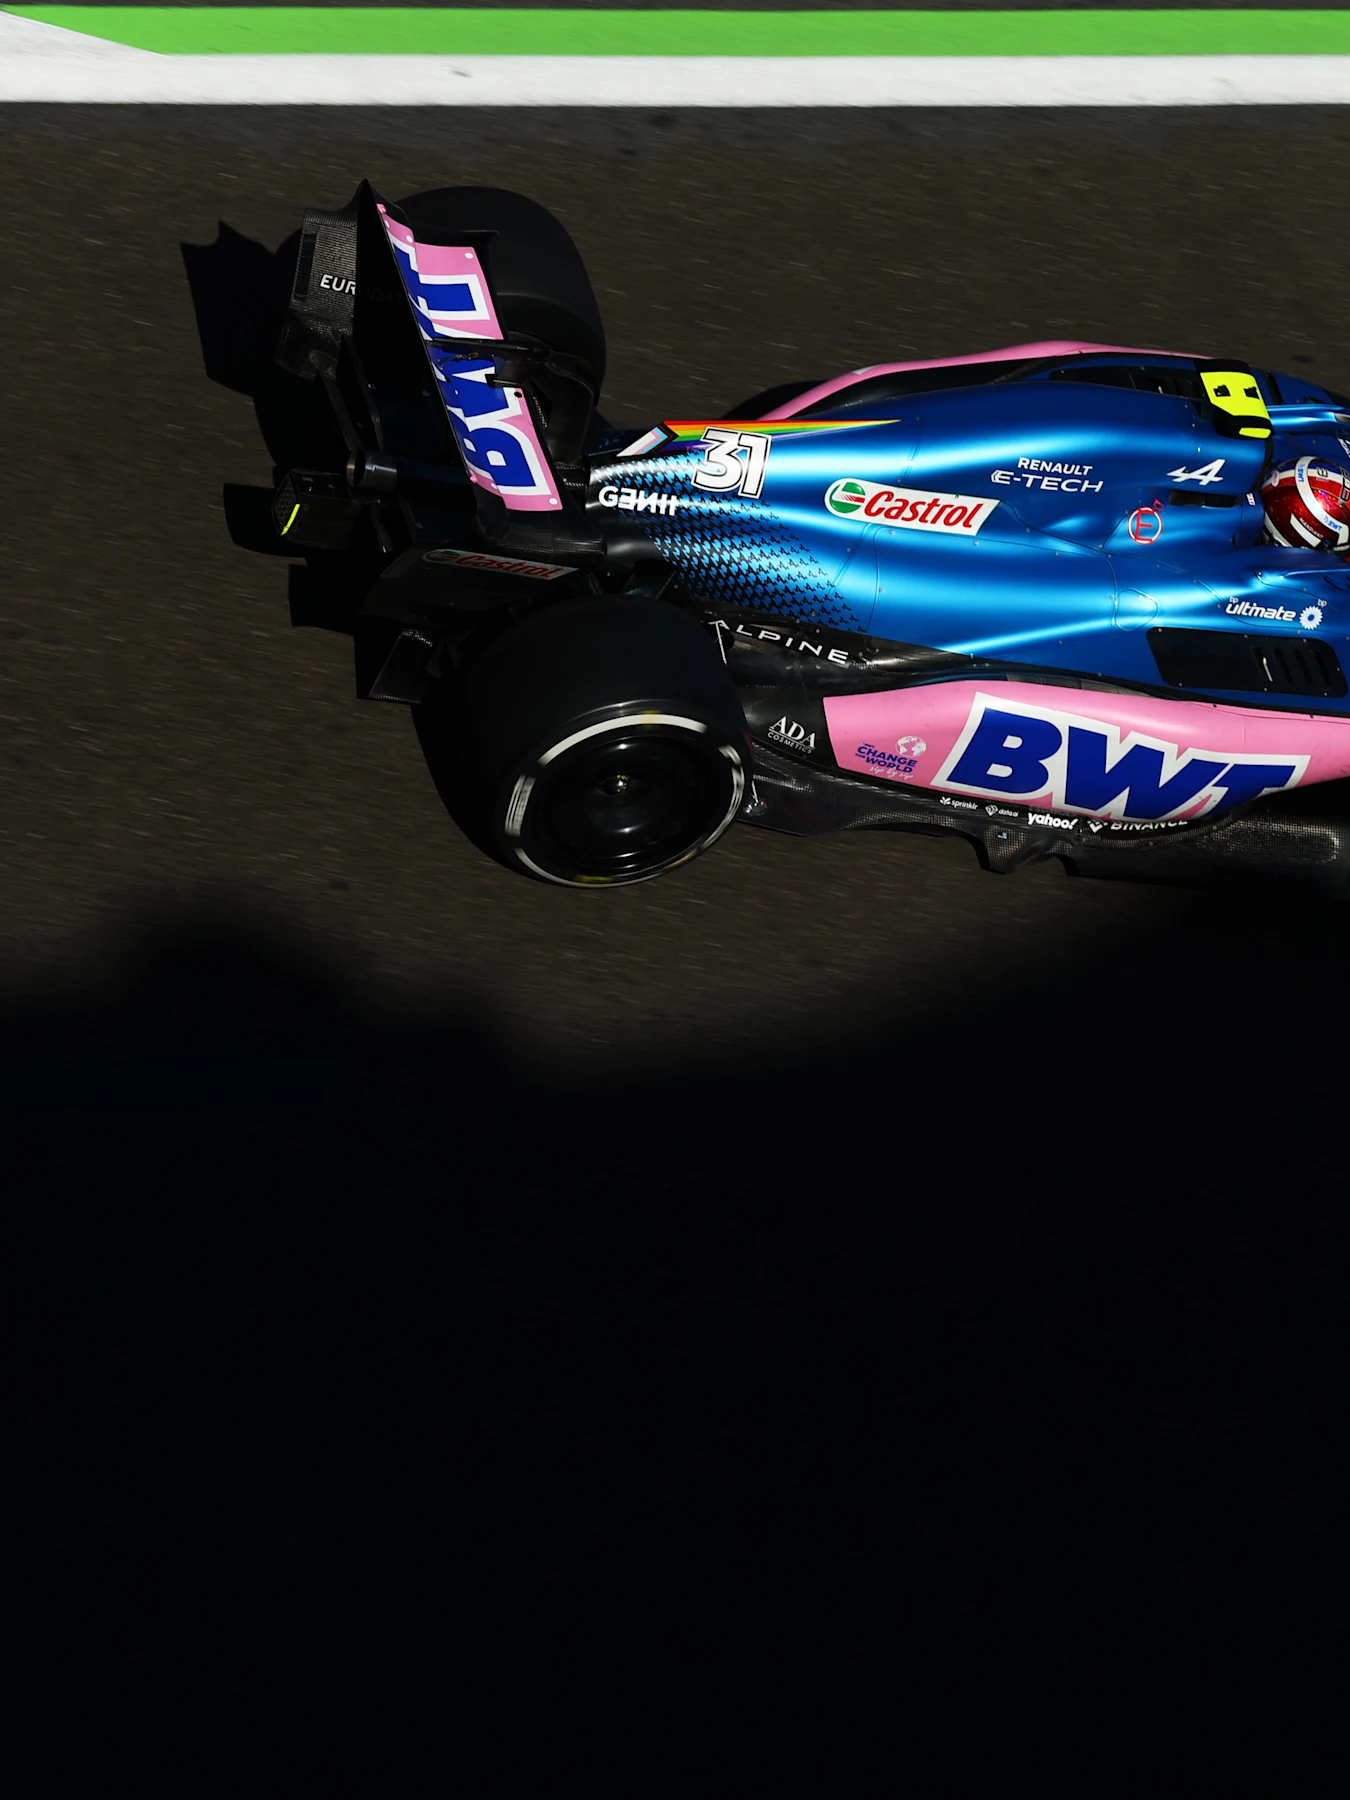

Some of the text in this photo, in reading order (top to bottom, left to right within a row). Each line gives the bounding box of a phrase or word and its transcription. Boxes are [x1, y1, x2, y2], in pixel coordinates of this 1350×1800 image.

[690, 425, 773, 499] 31
[1018, 457, 1093, 476] RENAULT
[991, 469, 1105, 493] E-TECH
[864, 490, 983, 529] Castrol
[455, 555, 565, 578] Castrol
[1225, 601, 1297, 622] ultimate
[709, 619, 849, 665] ALPINE
[767, 731, 813, 755] COSMETICS
[769, 716, 818, 750] ADA
[857, 746, 918, 768] CHANGE
[866, 756, 913, 773] WORLD
[946, 707, 1297, 821] BWT
[1027, 811, 1080, 831] yahoo!
